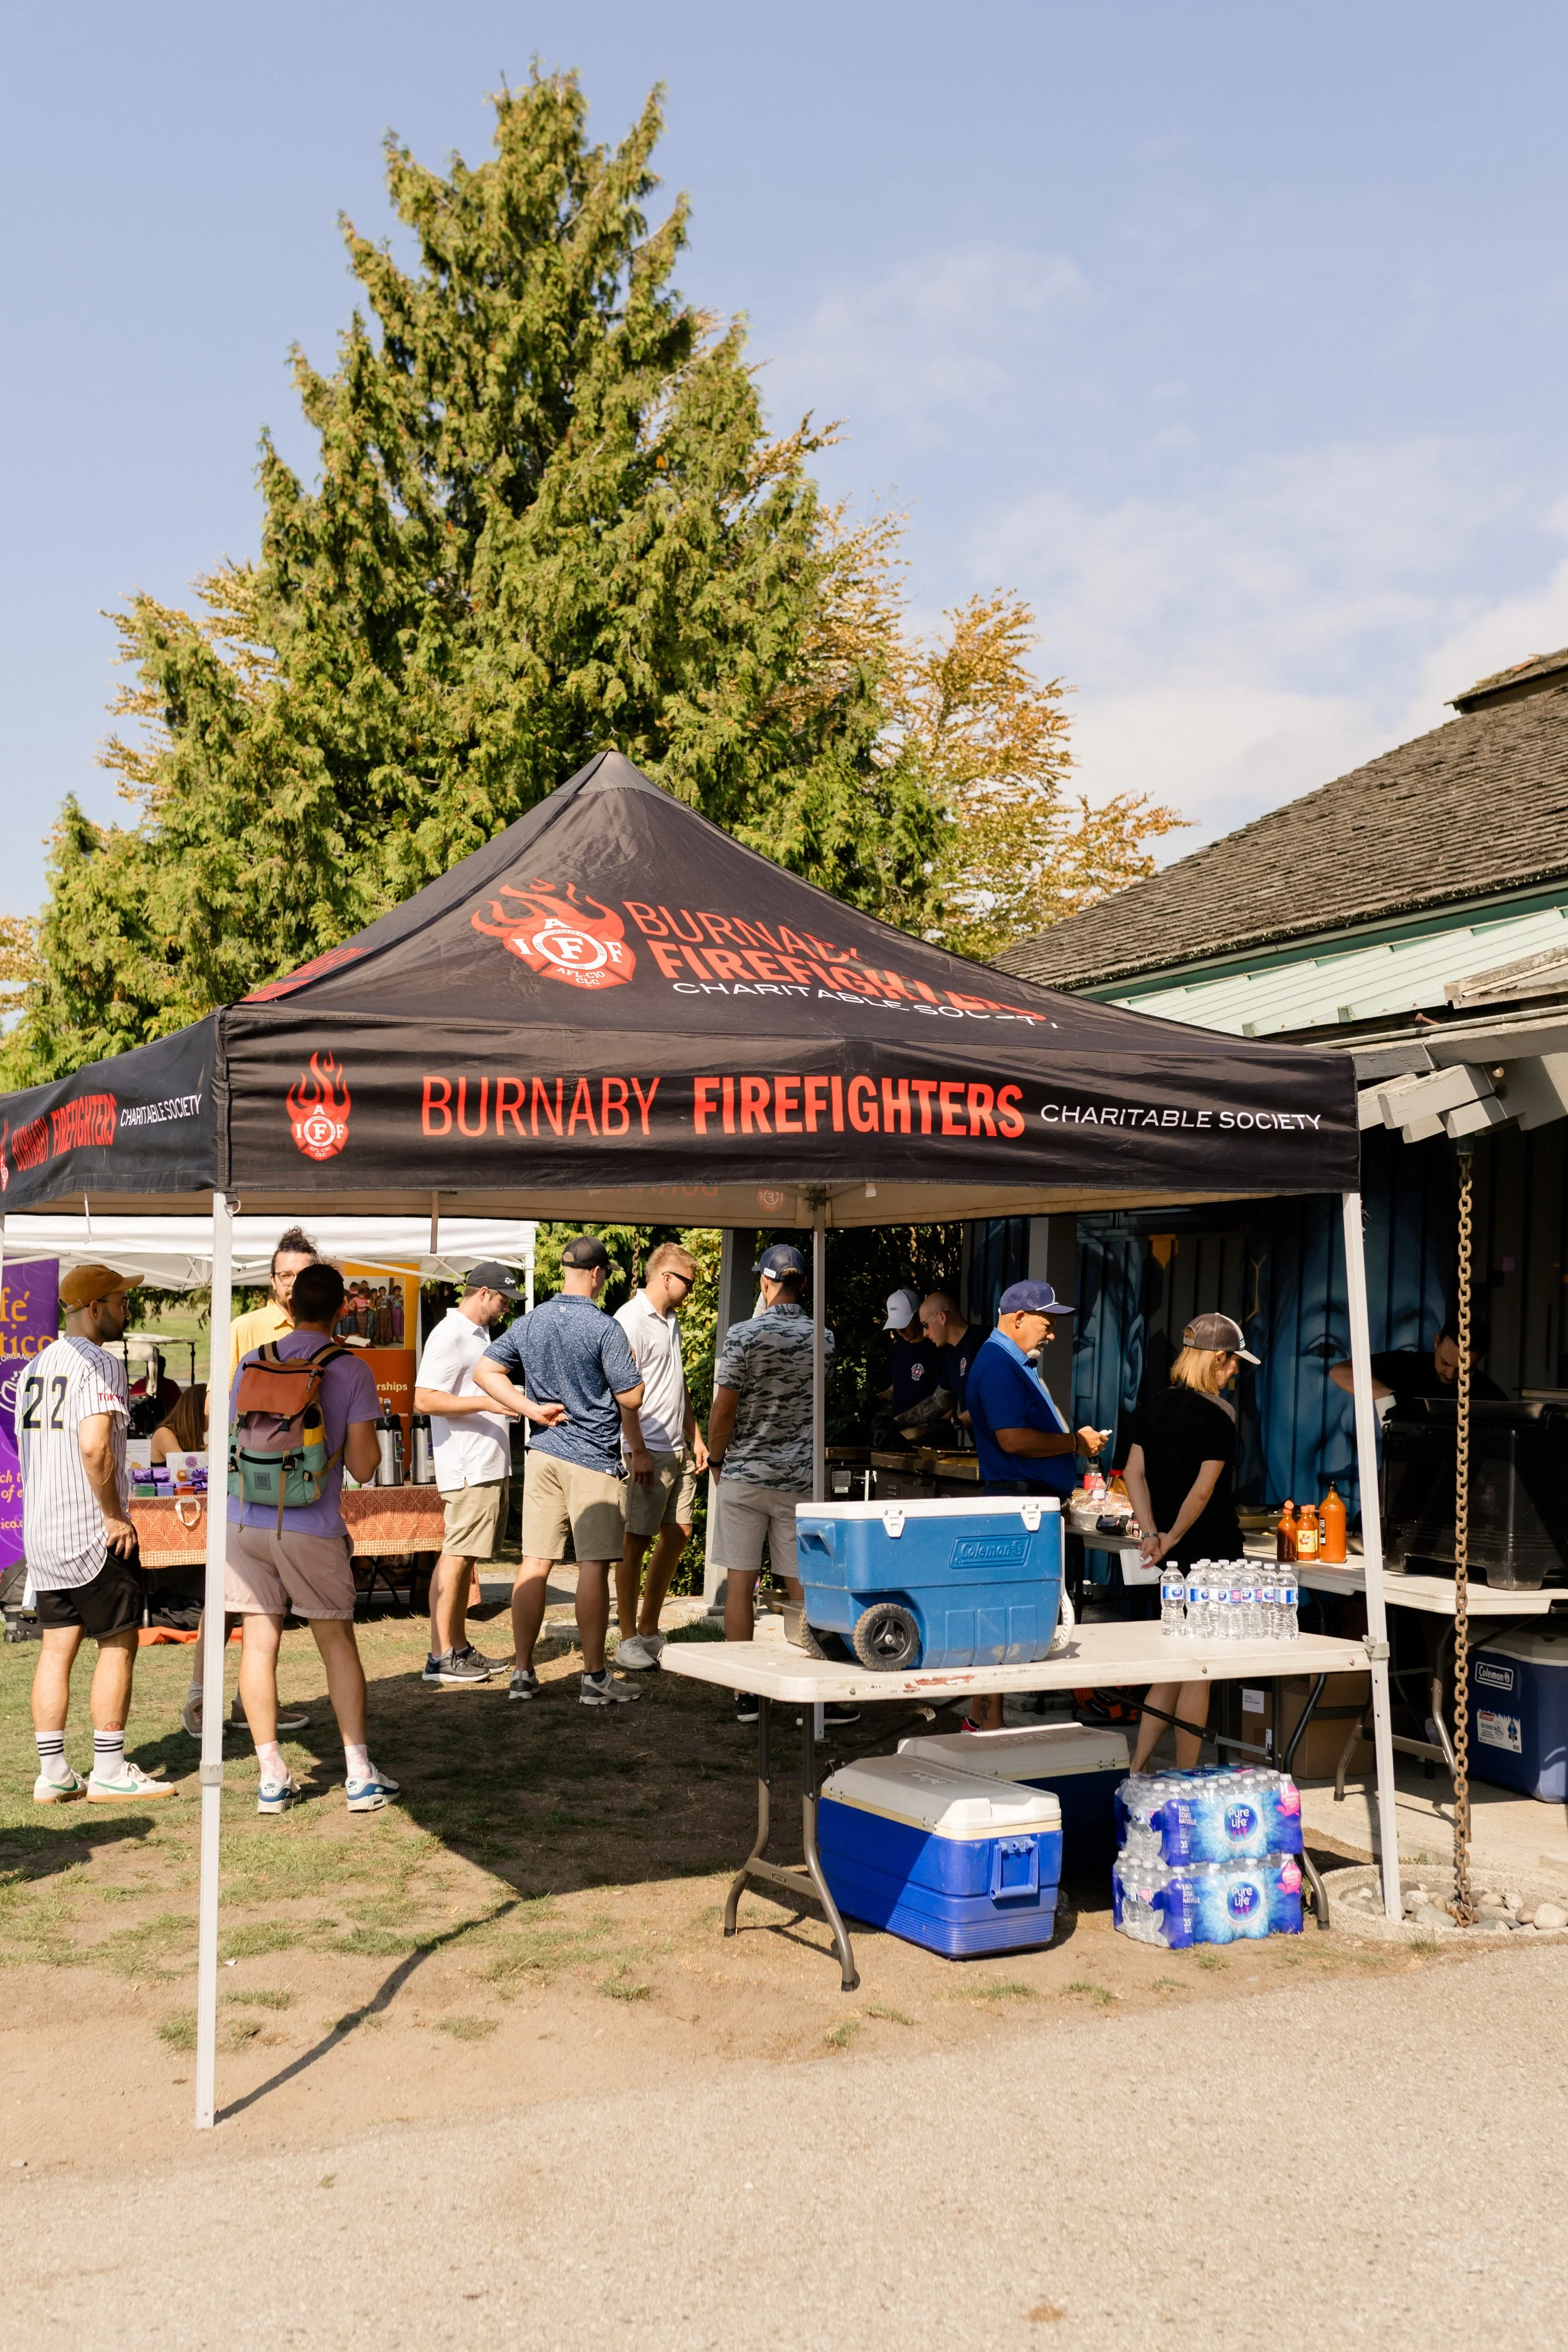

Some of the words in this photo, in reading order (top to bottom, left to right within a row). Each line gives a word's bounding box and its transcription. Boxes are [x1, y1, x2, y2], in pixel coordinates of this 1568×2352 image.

[556, 968, 605, 978] AFL-CIO
[575, 977, 600, 985] CLC
[672, 982, 909, 1012] CHARITABLE
[421, 1076, 659, 1137] BURNABY
[693, 1075, 1025, 1138] FIREFIGHTERS
[1040, 1104, 1212, 1127] CHARITABLE
[1219, 1111, 1322, 1130] SOCIETY
[50, 1093, 118, 1158] FIREFIGHTERS
[120, 1102, 167, 1127] CHARITABLE
[164, 1094, 203, 1120] SOCIETY
[21, 1374, 68, 1431] 22
[98, 1393, 125, 1405] TOKYO
[960, 1542, 1010, 1560] Coleman
[1479, 1665, 1504, 1682] Coleman
[1229, 1808, 1250, 1818] Pure
[1231, 1818, 1248, 1829] Life
[1180, 1840, 1188, 1849] 35
[1232, 1887, 1253, 1897] Pure
[1235, 1897, 1250, 1907] Life
[1183, 1918, 1191, 1927] 35
